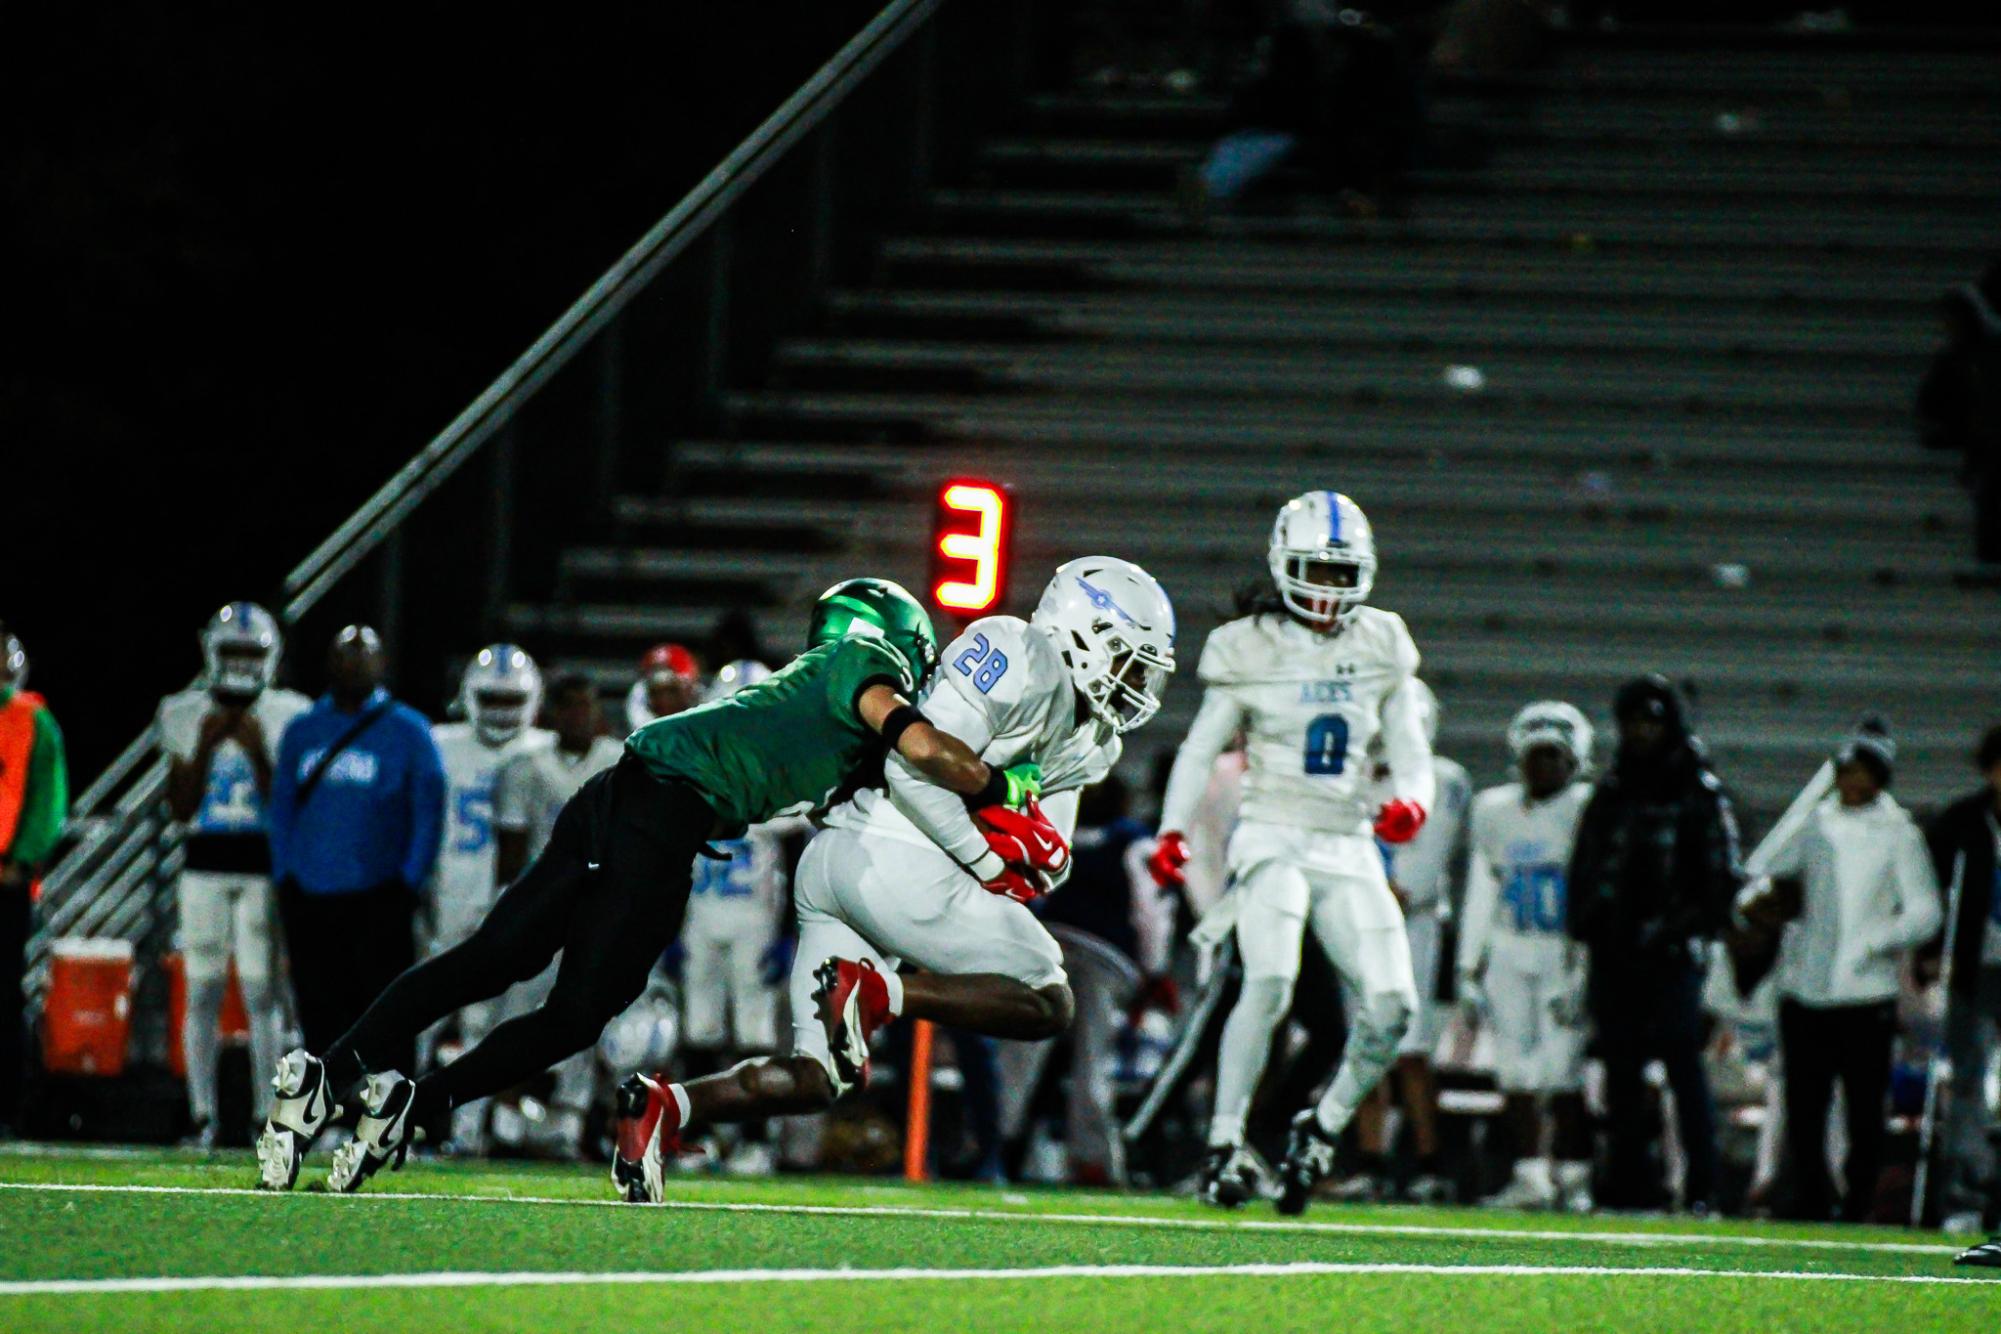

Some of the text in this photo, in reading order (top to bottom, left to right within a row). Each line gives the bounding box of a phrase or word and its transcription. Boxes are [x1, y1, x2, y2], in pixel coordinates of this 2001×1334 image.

[936, 485, 1003, 610] 3
[952, 632, 1009, 695] 28
[1304, 713, 1349, 775] 0
